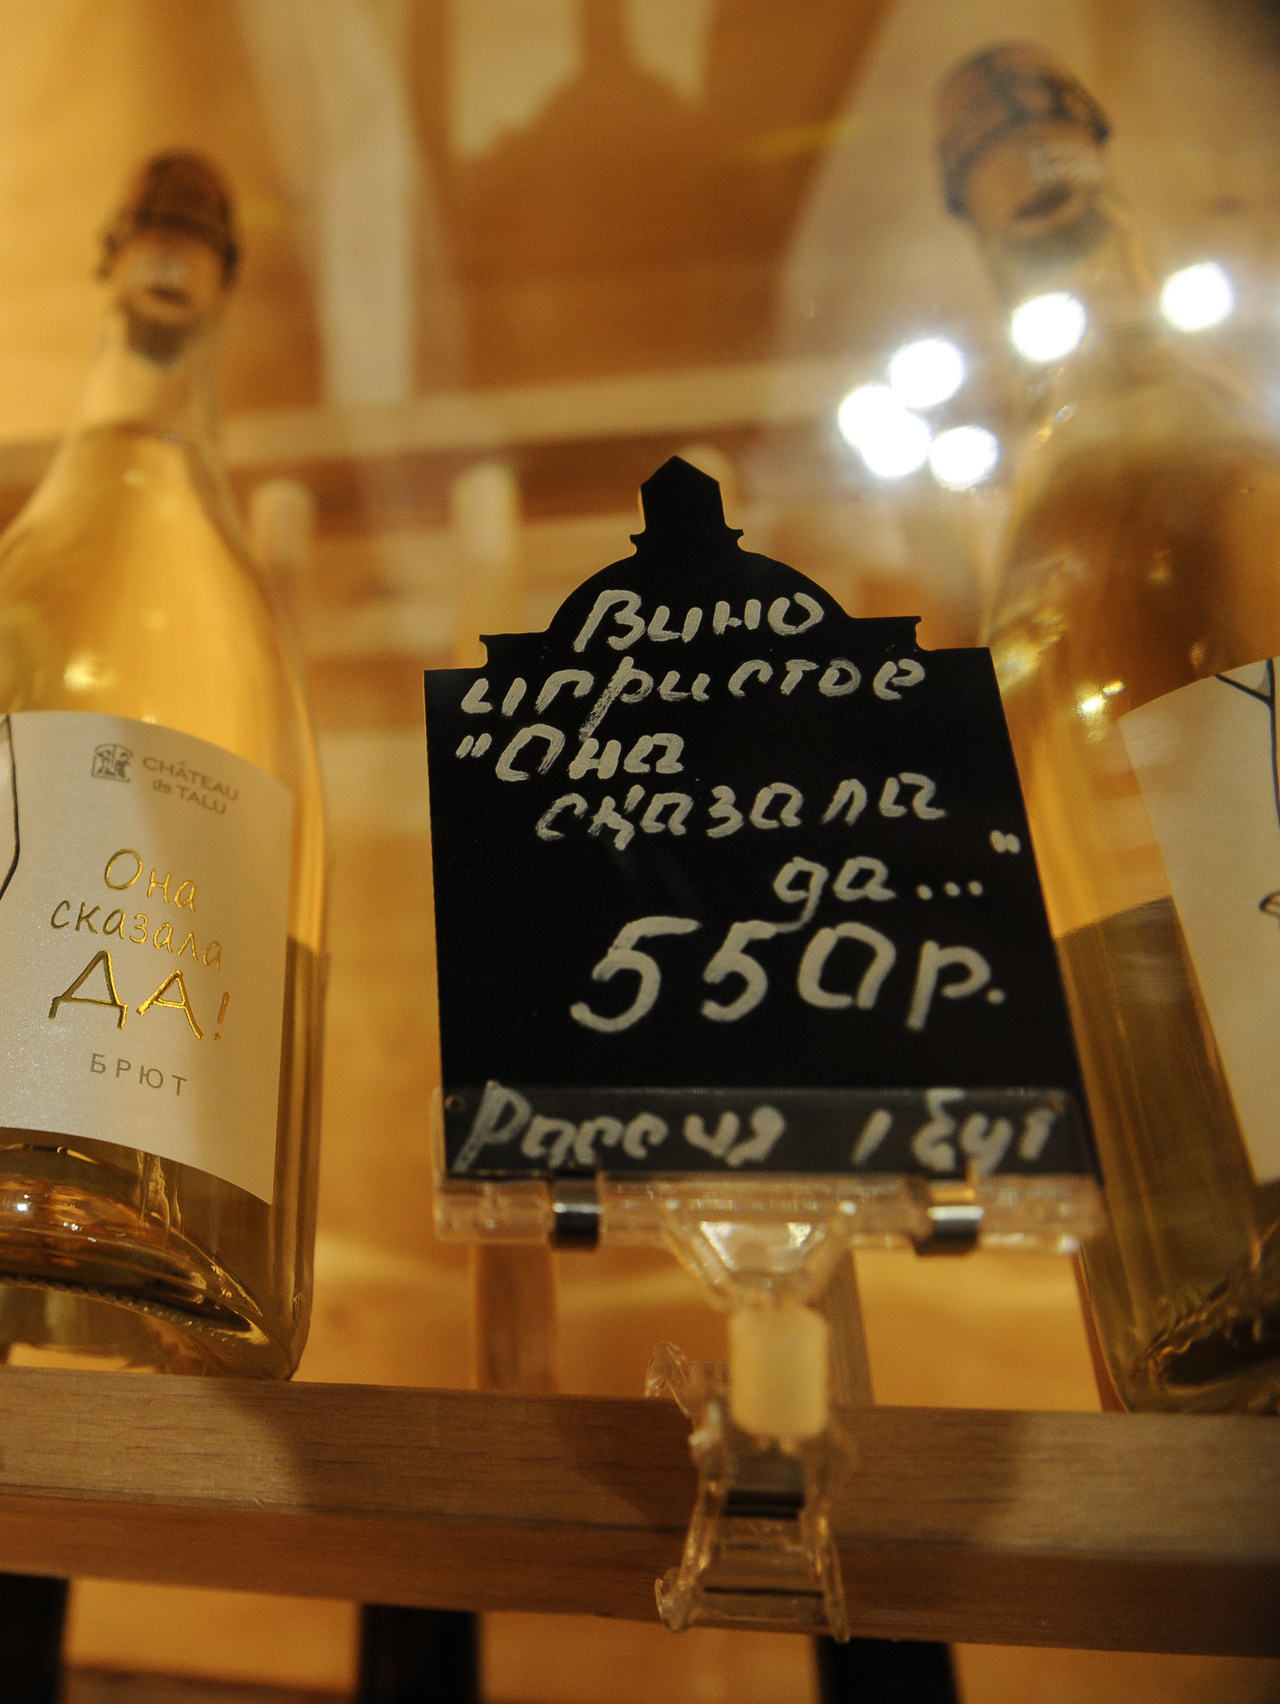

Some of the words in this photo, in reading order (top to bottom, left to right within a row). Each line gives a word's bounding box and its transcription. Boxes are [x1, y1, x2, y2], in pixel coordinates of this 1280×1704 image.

[573, 589, 825, 652] Вино
[460, 656, 926, 742] игристое
[143, 757, 239, 802] CHÂTEAU
[177, 785, 227, 814] TALU
[535, 772, 947, 850] сказала
[104, 848, 196, 913] Она
[50, 900, 222, 970] сказала
[48, 950, 231, 1042] ДА!
[89, 1053, 189, 1097] БРЮТ
